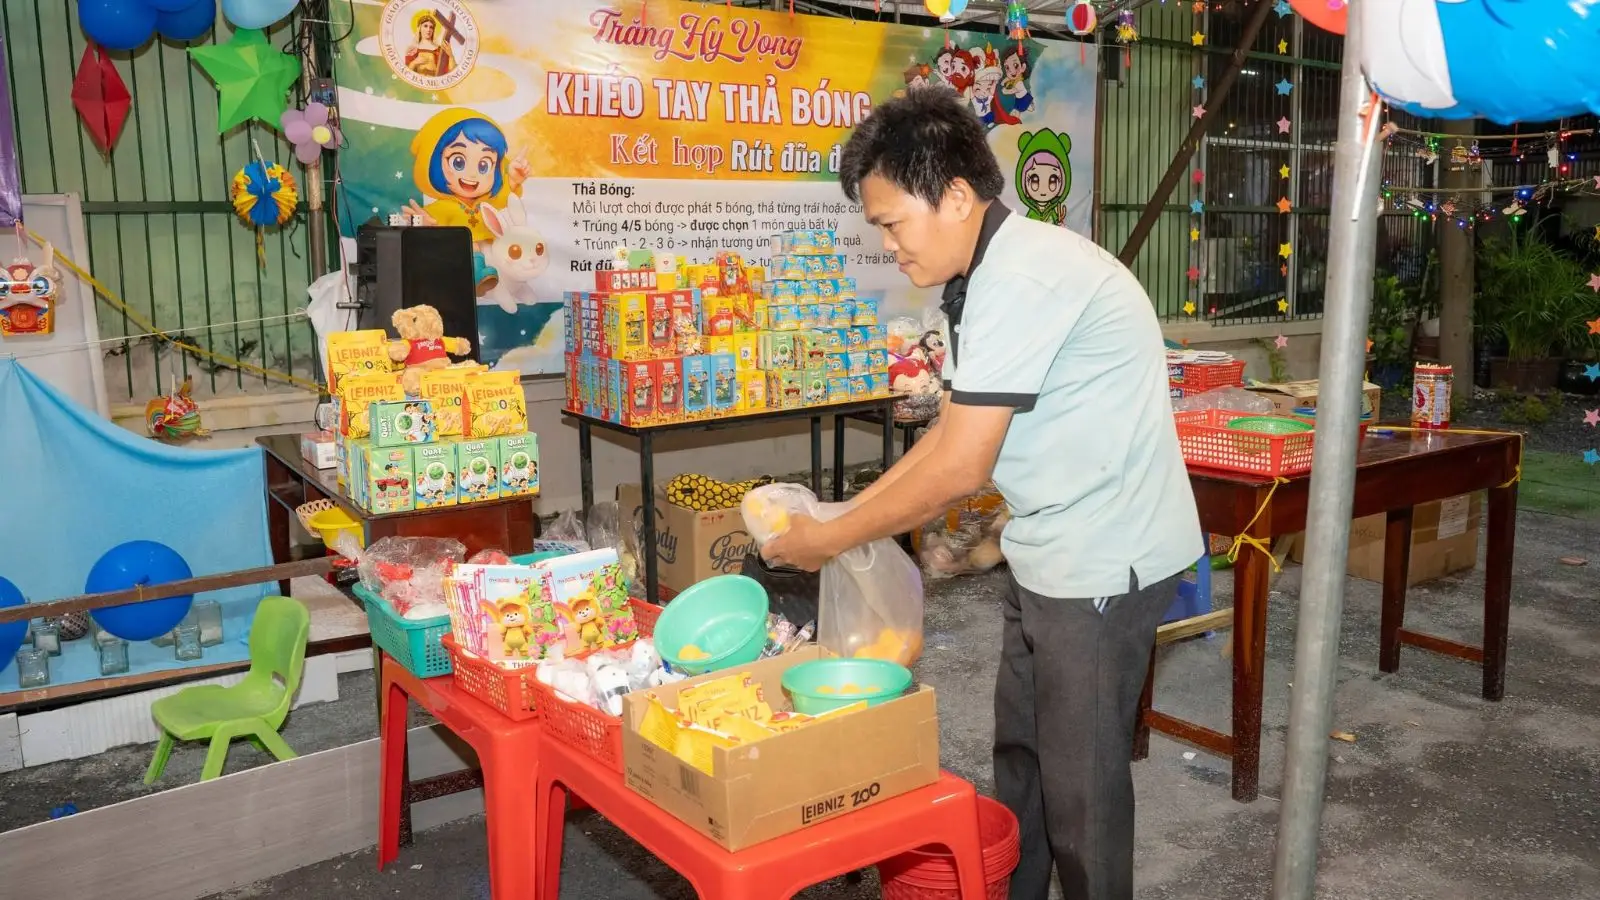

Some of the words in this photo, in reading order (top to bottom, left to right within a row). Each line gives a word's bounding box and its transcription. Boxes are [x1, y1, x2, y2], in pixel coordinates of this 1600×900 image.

[590, 8, 696, 61] Trăng
[680, 12, 745, 63] Hy
[731, 18, 803, 70] Vọng
[653, 78, 712, 121] TAY
[719, 74, 782, 125] THẢ
[791, 78, 872, 128] BÓNG
[610, 133, 658, 165] Kết
[672, 135, 725, 174] hợp
[731, 139, 774, 172] Rút
[780, 142, 822, 173] đũa
[828, 143, 842, 173] đ
[572, 182, 596, 196] Thả
[599, 183, 635, 198] Bóng:
[573, 200, 597, 214] Mỗi
[599, 201, 623, 216] lượt
[626, 201, 651, 214] chơi
[655, 201, 685, 216] được
[688, 202, 713, 216] phát
[715, 203, 723, 214] 5
[726, 202, 755, 216] bóng,
[758, 202, 774, 214] thả
[777, 203, 801, 216] từng
[803, 202, 820, 214] trái
[823, 202, 846, 215] hoặc
[583, 219, 618, 234] Trúng
[621, 219, 642, 232] 4/5
[644, 219, 674, 233] bóng
[690, 220, 719, 233] được
[722, 219, 749, 233] chọn
[752, 220, 757, 231] 1
[761, 219, 784, 230] món
[787, 220, 806, 231] quà
[808, 218, 825, 231] bất
[827, 219, 839, 232] kỳ
[640, 238, 647, 249] 2
[656, 238, 664, 249] 3
[667, 236, 674, 249] ô
[691, 236, 718, 250] nhận
[722, 238, 753, 249] tương
[570, 259, 592, 271] Rút
[857, 254, 863, 265] 2
[865, 253, 881, 265] trái
[337, 346, 382, 362] LEIBNIZ
[351, 361, 374, 370] ZOO
[350, 385, 397, 401] LEIBNIZ
[427, 383, 463, 398] LEIBNI
[472, 386, 516, 403] LEIBNIZ
[440, 396, 462, 407] ZOO
[483, 399, 508, 412] ZOO
[802, 794, 845, 825] LEIBNIZ
[851, 782, 881, 807] ZOO
